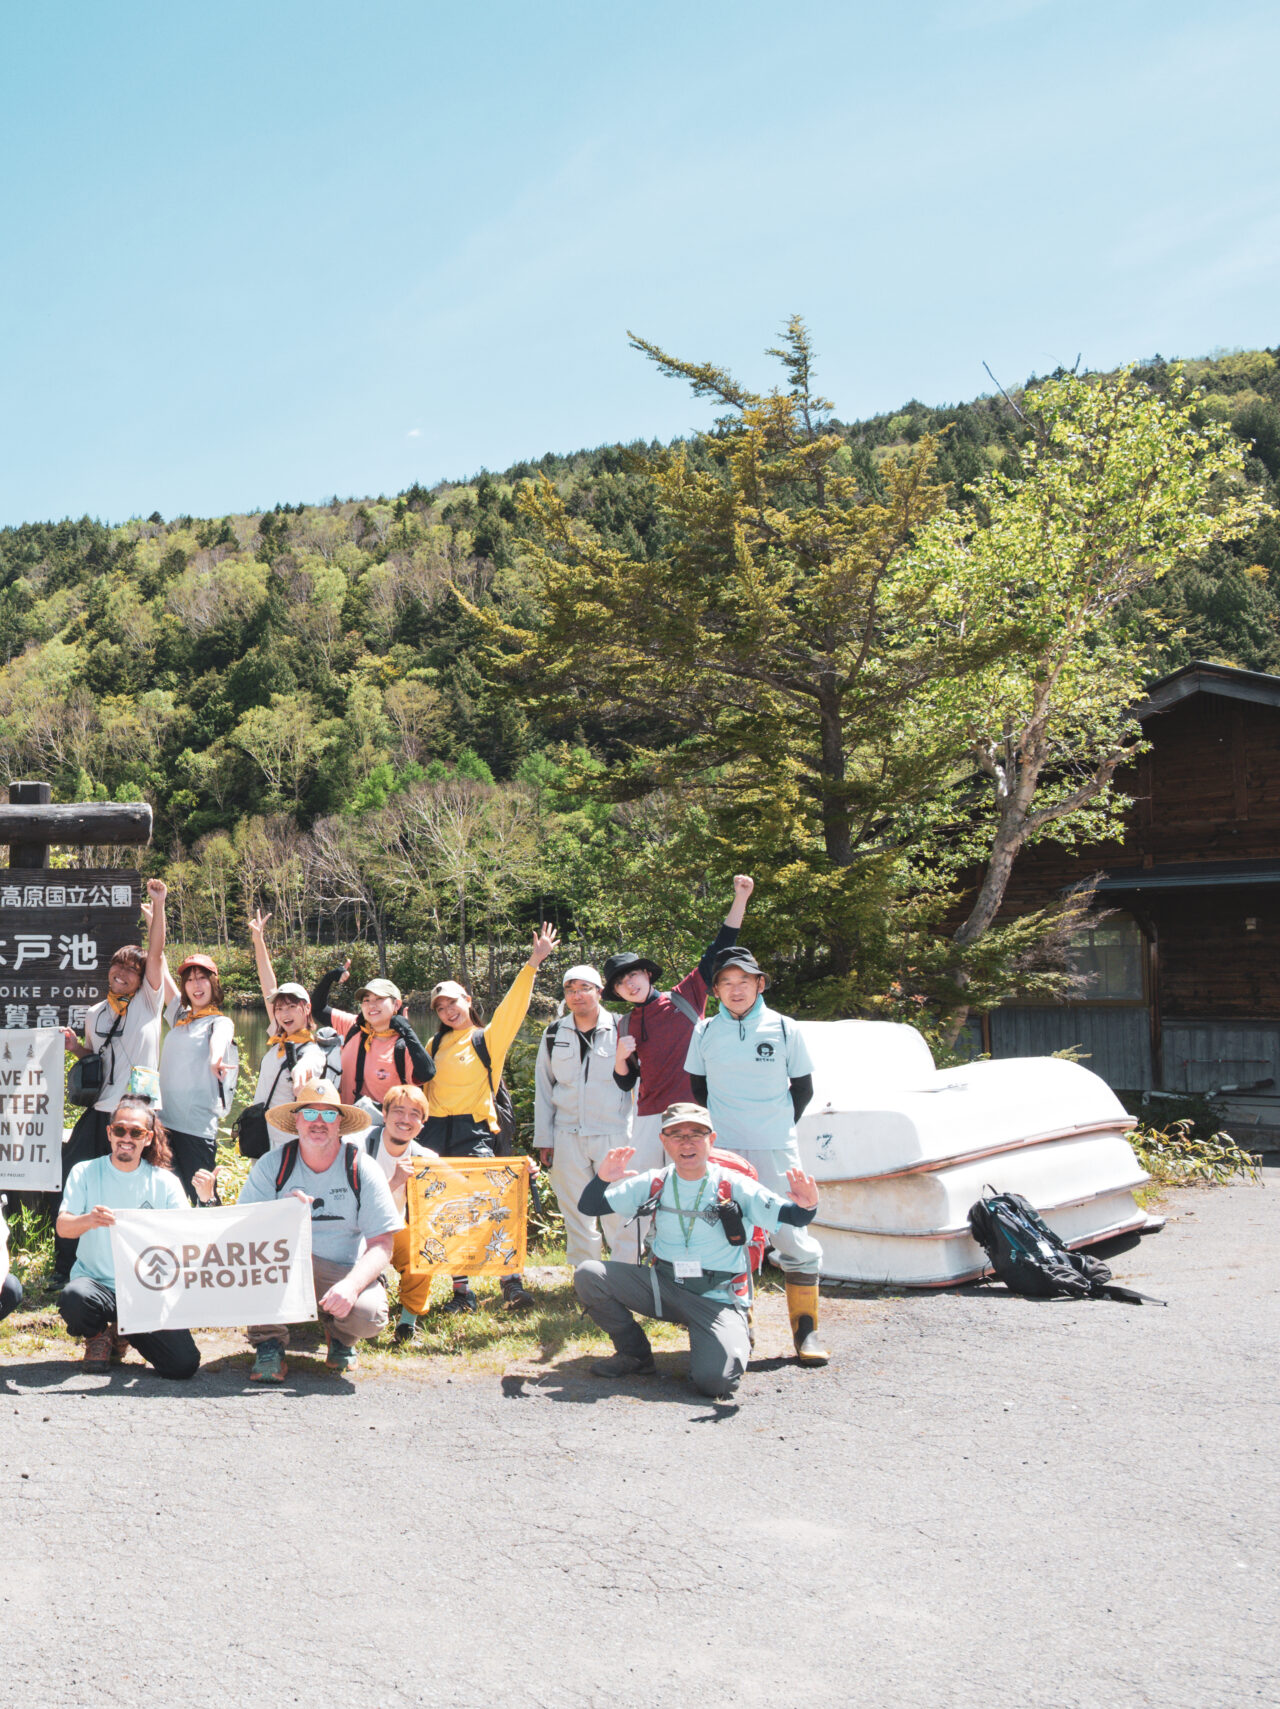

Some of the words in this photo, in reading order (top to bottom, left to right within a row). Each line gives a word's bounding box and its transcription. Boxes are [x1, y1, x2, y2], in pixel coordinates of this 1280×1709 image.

[50, 986, 99, 998] POND
[28, 1070, 44, 1086] IT
[16, 1122, 44, 1136] YOU
[30, 1144, 50, 1163] IT.
[182, 1239, 290, 1268] PARKS
[184, 1265, 291, 1289] PROJECT
